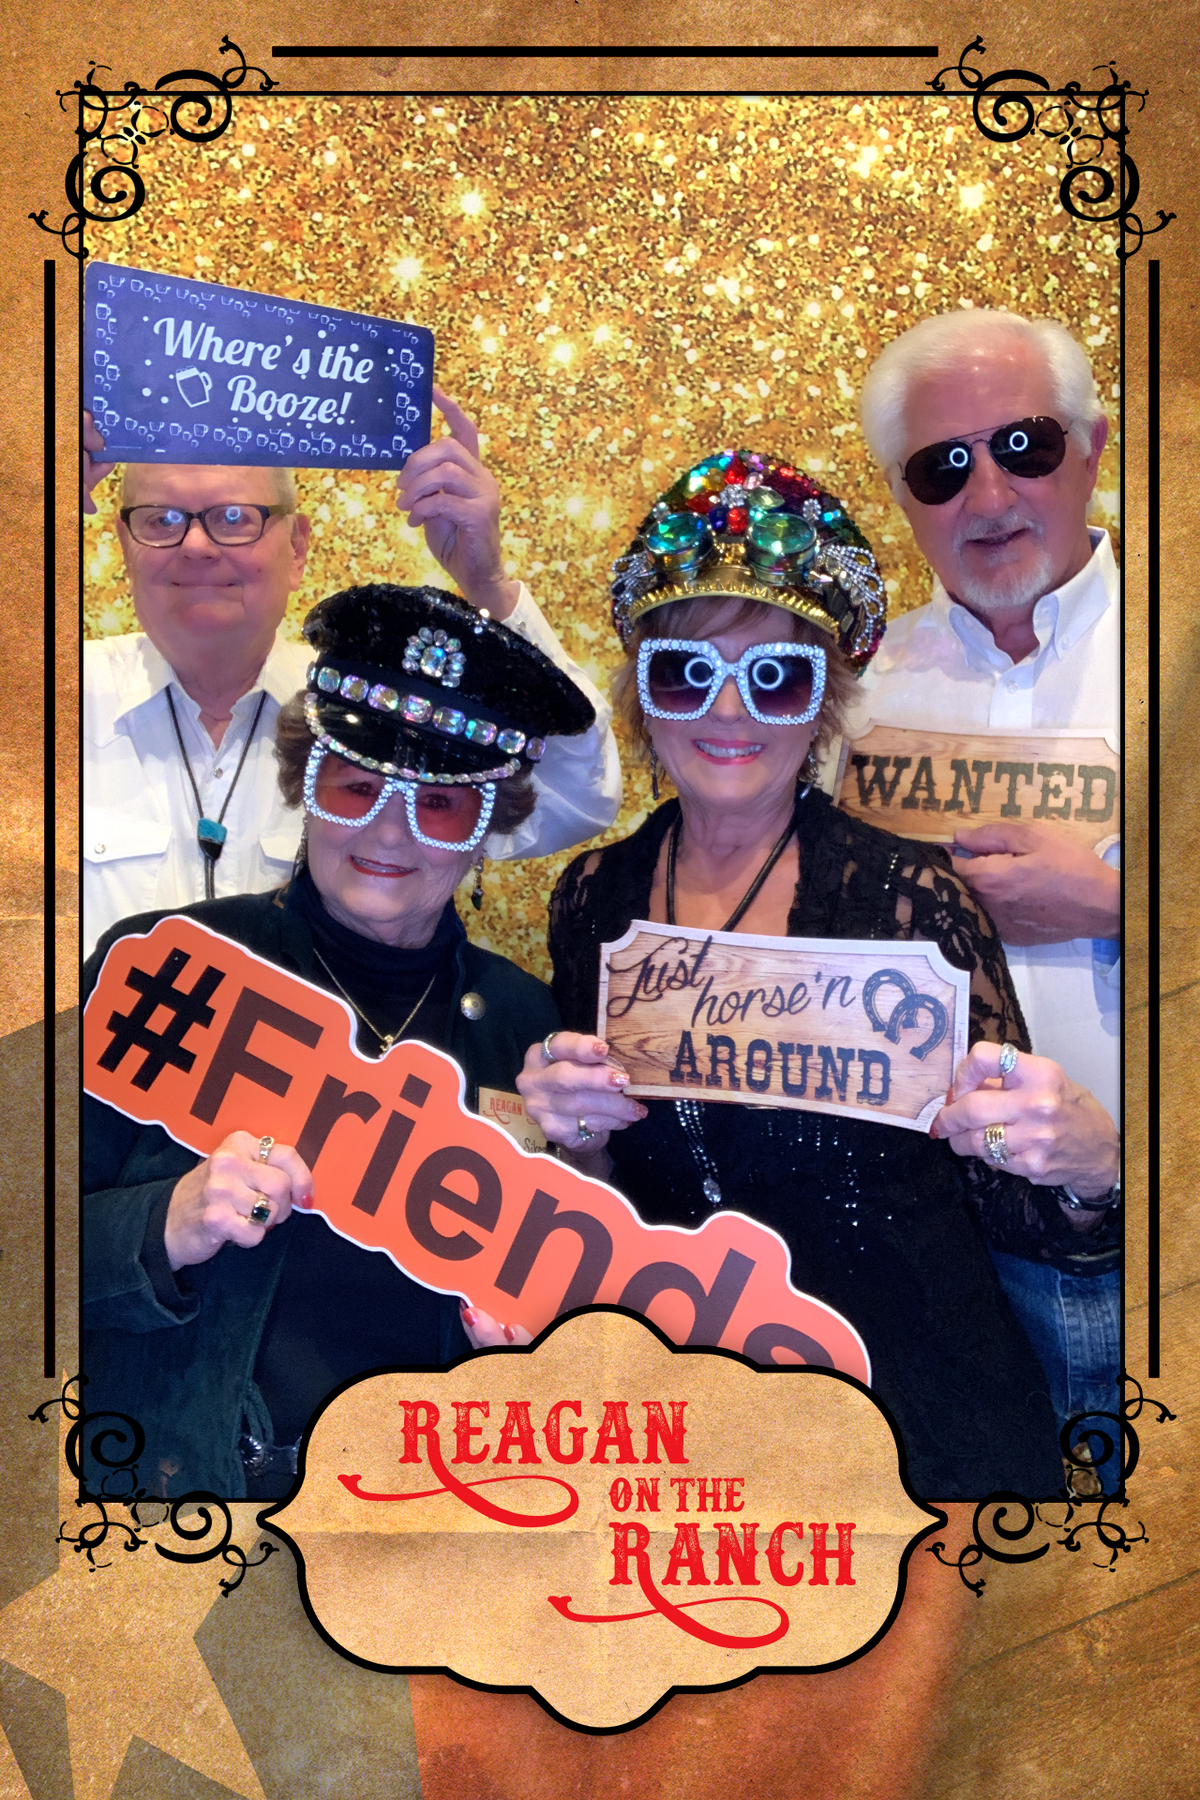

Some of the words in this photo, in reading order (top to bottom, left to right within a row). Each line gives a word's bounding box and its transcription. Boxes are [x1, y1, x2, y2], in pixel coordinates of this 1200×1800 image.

[153, 317, 311, 376] Where's
[319, 344, 374, 384] the
[227, 375, 352, 426] Booze!
[851, 754, 1116, 823] WANTED
[605, 935, 713, 1018] Just
[691, 970, 856, 1028] horse'n
[669, 1030, 892, 1106] AROUND
[483, 1097, 523, 1125] REAGAN
